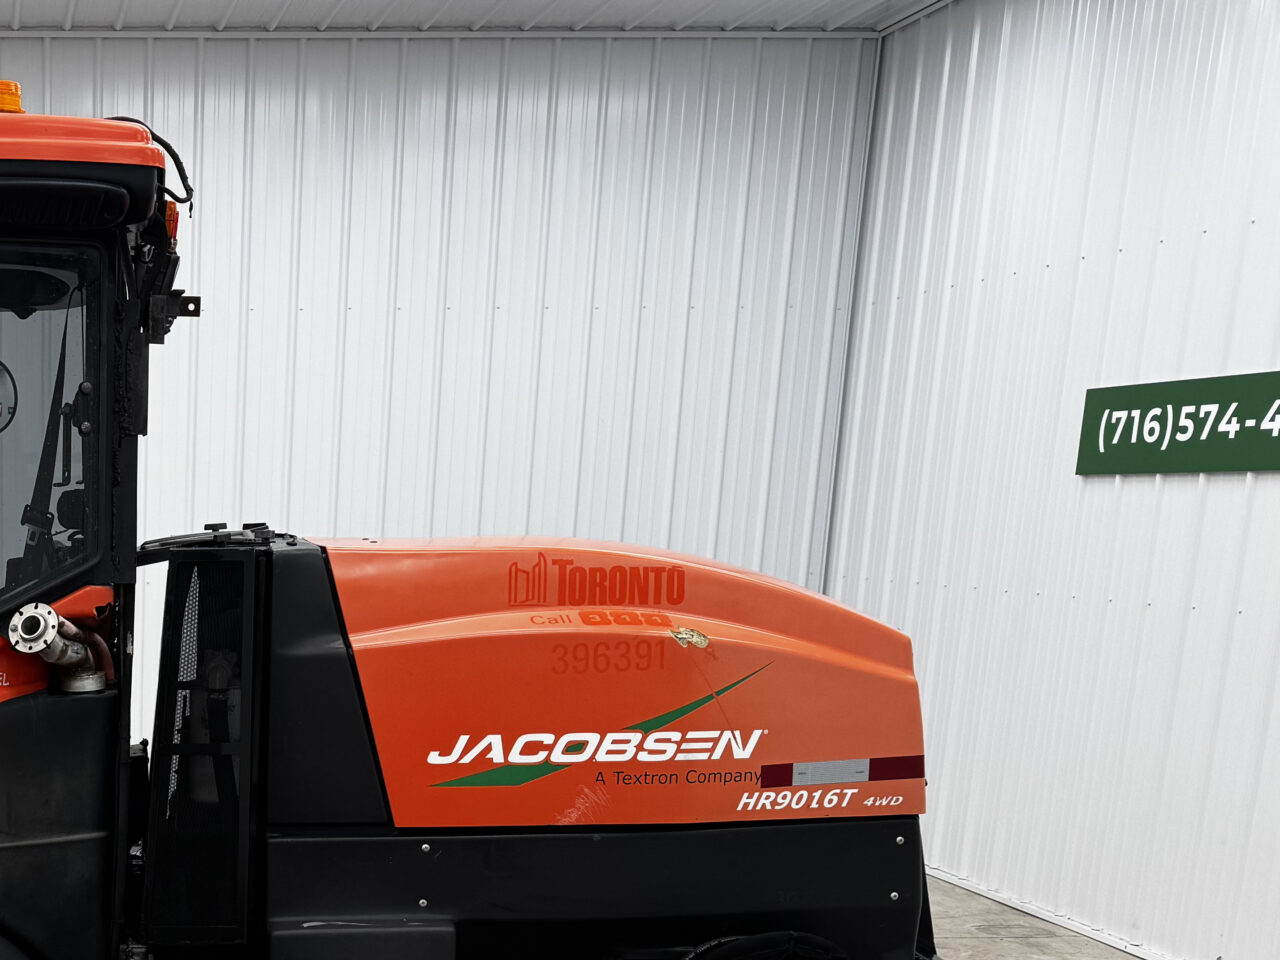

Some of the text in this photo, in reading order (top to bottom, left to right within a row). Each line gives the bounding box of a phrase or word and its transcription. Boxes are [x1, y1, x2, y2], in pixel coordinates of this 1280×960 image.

[1098, 399, 1280, 453] (716)574-4
[552, 559, 685, 607] TORONTO
[530, 614, 573, 625] Call
[551, 638, 666, 675] 396391
[426, 729, 764, 764] JACOBSEN
[595, 769, 762, 787] A Textron Company
[736, 788, 904, 812] HR9016T 4WD
